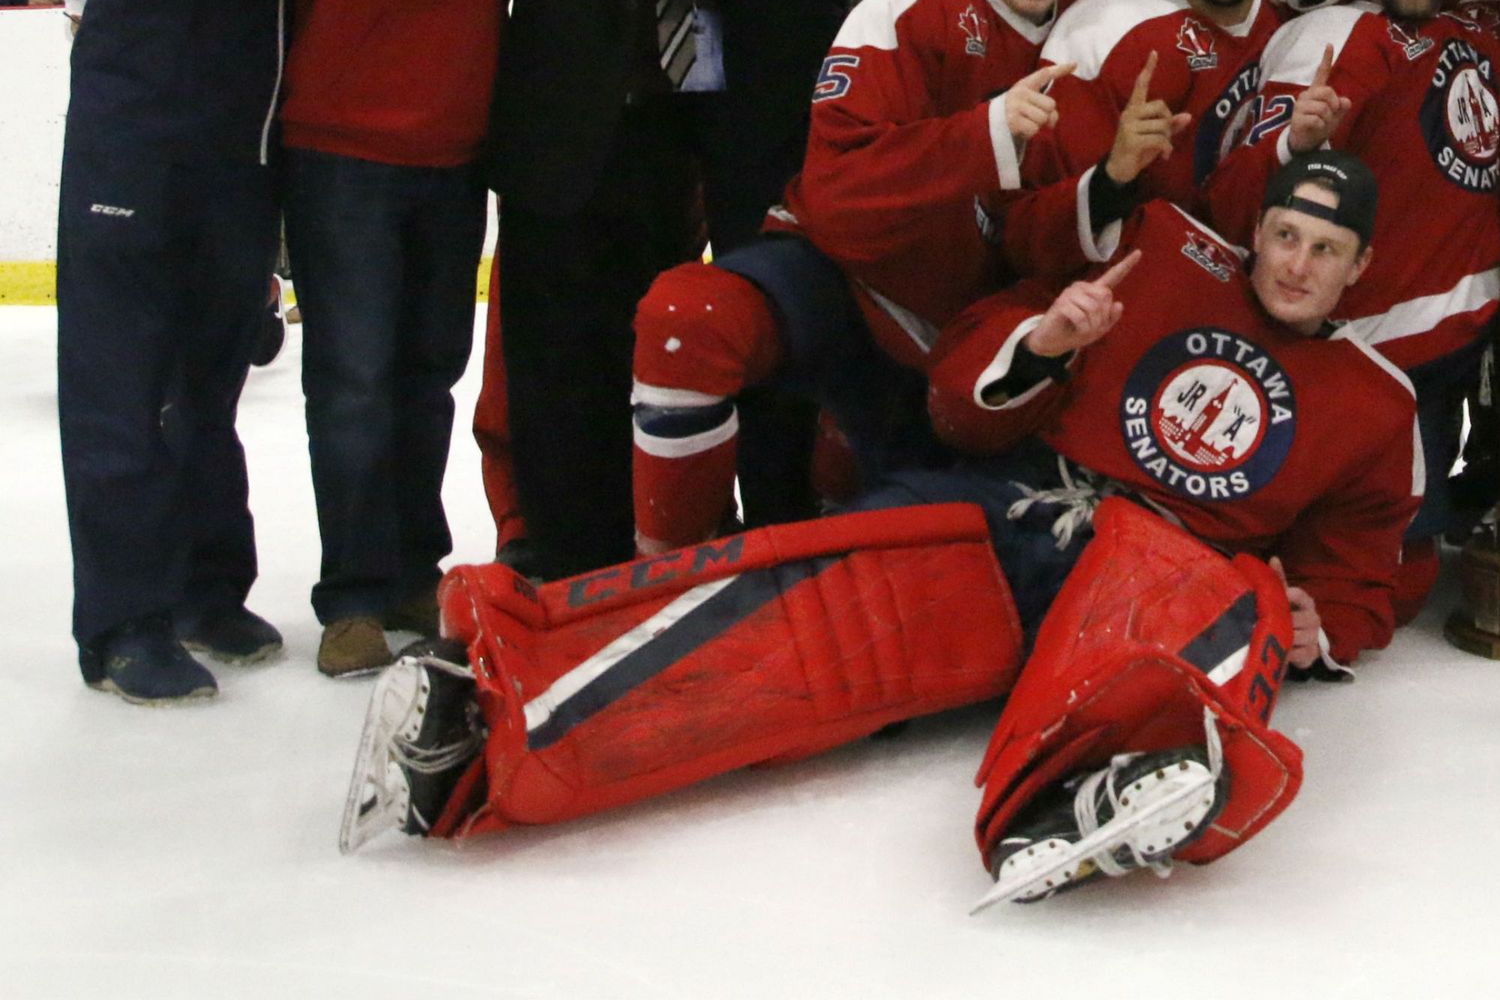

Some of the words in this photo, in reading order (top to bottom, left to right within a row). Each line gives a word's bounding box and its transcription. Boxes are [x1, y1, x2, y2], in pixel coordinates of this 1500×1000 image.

[1177, 380, 1207, 423] JR
[1186, 332, 1293, 426] OTTAWA
[1125, 396, 1250, 499] SENATORS
[567, 534, 745, 610] CCM
